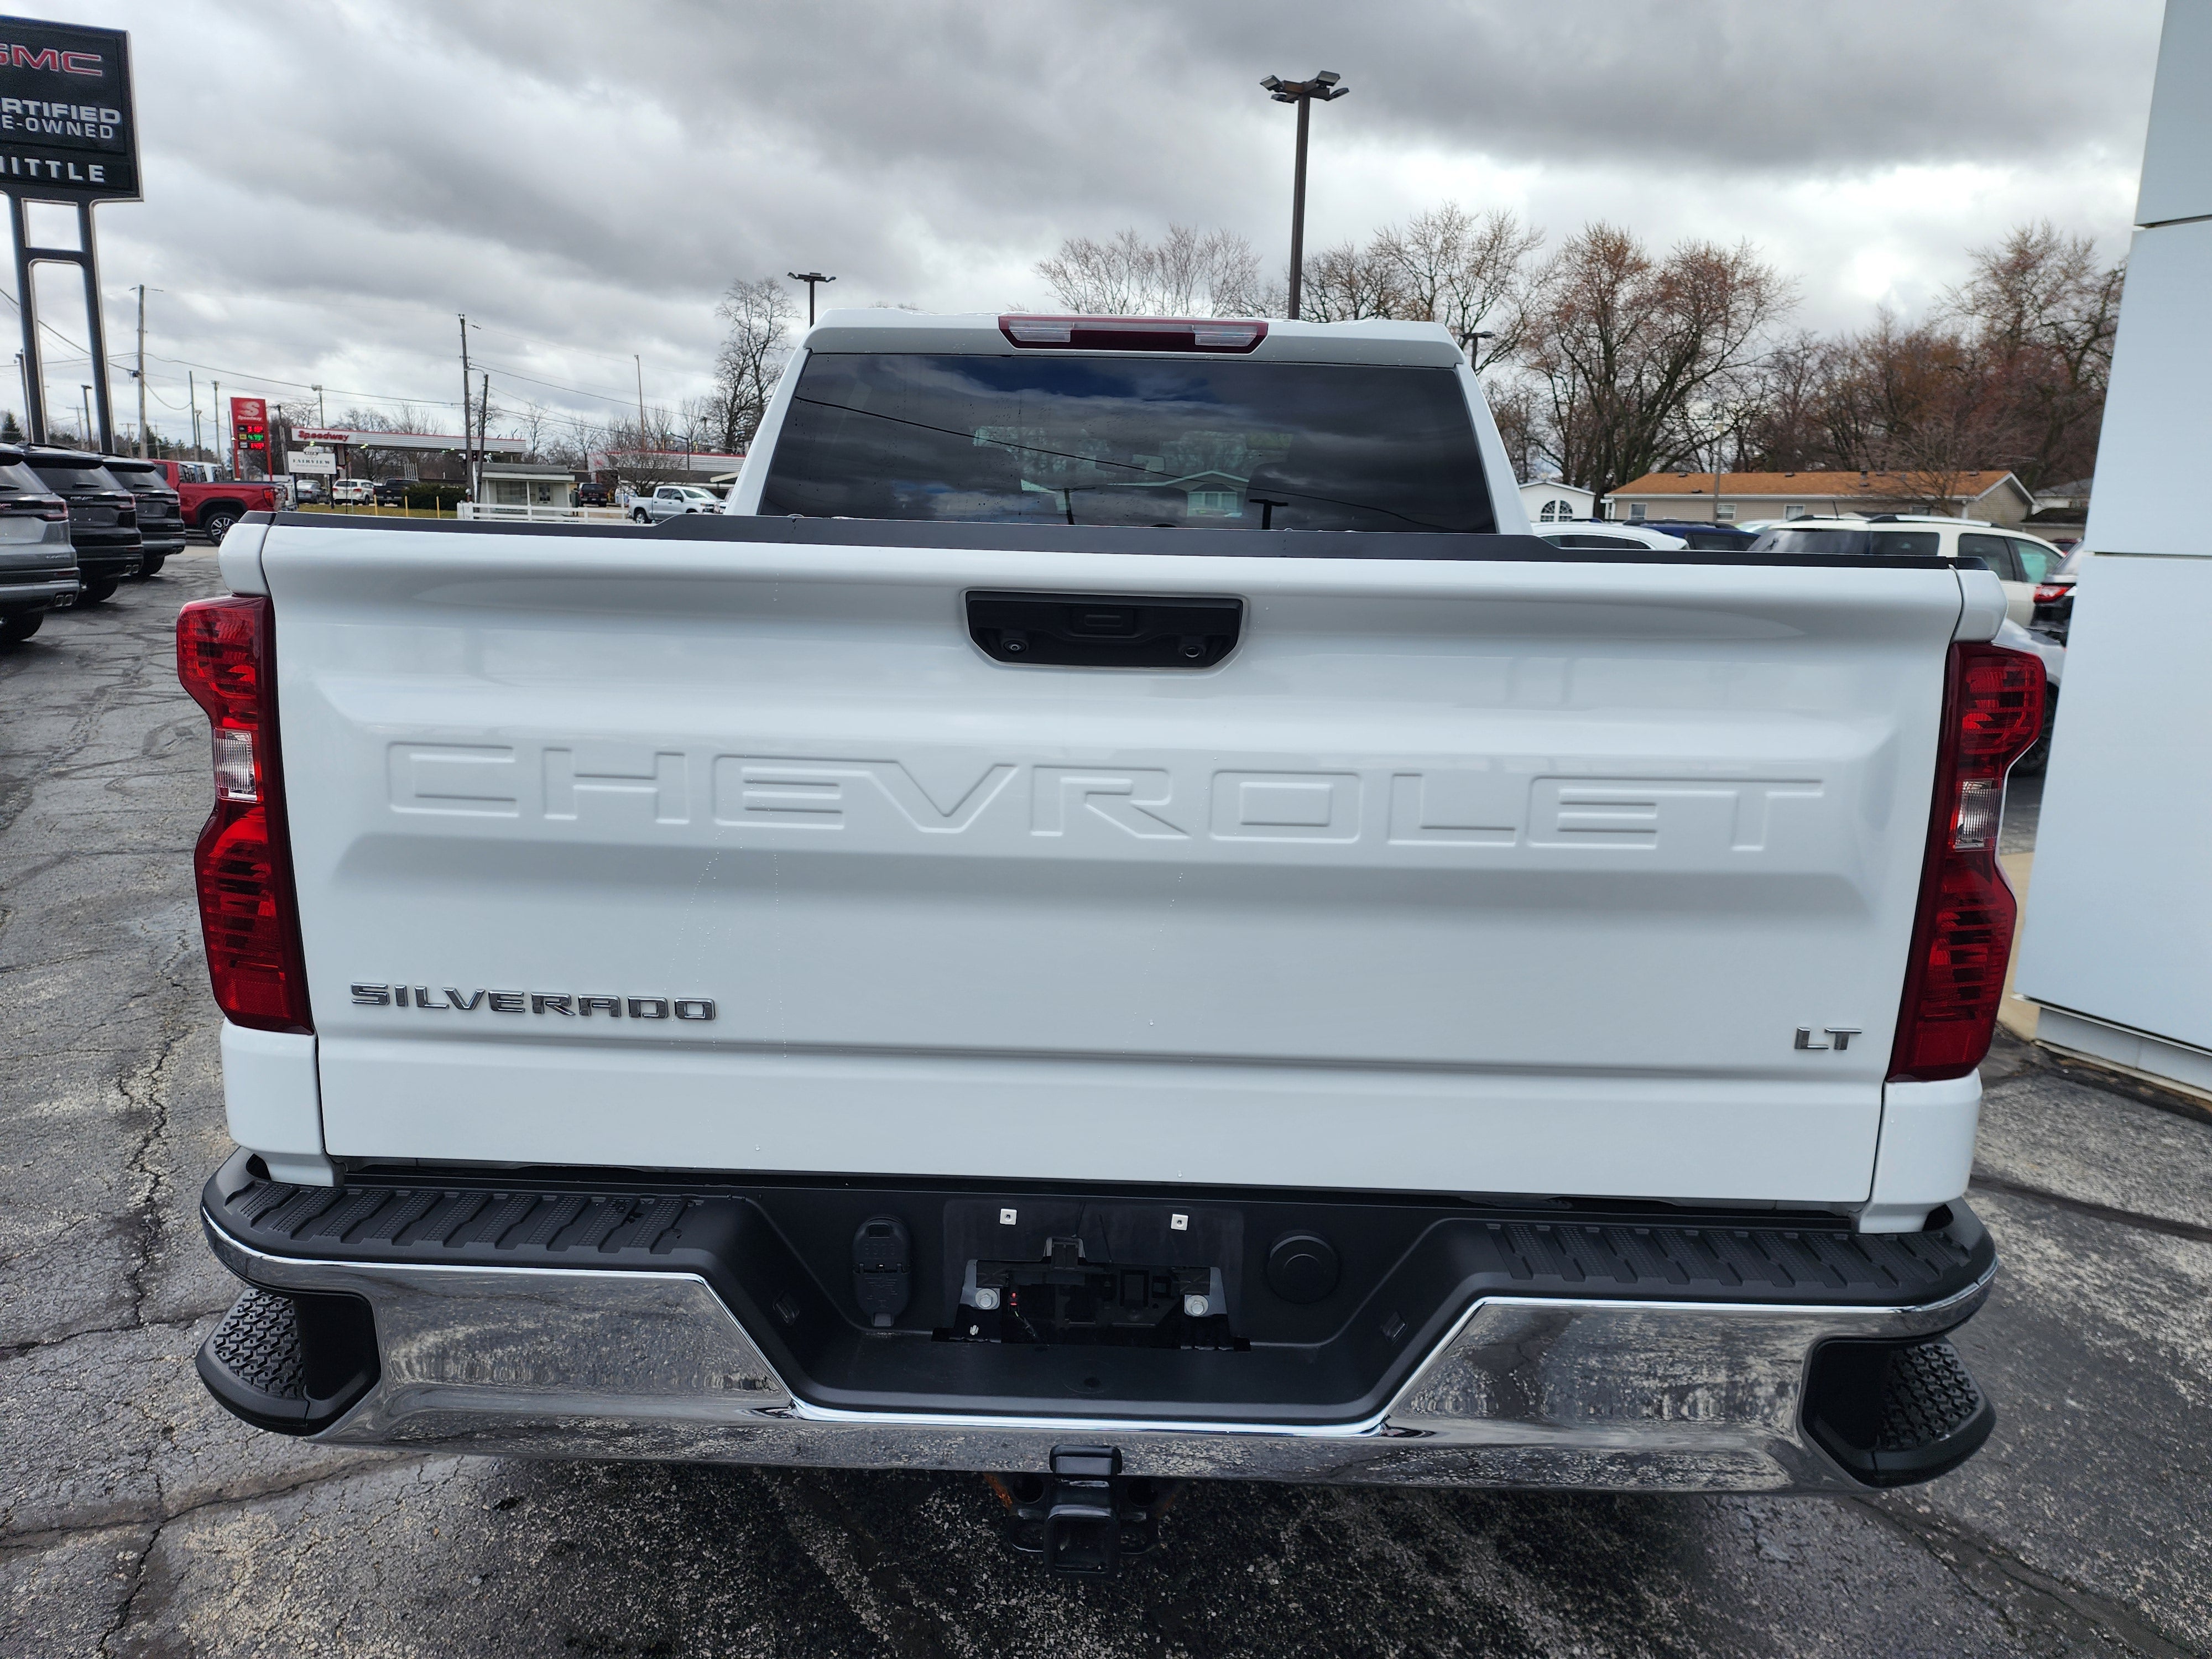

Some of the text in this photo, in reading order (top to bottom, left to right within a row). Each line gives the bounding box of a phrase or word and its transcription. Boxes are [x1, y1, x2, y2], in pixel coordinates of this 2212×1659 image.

[0, 43, 103, 76] MC
[0, 155, 105, 183] ITTLE
[298, 431, 349, 442] Speedway
[387, 742, 1824, 852] CHEVROLET
[350, 982, 717, 1020] SILVERADO
[1794, 1026, 1863, 1050] LT
